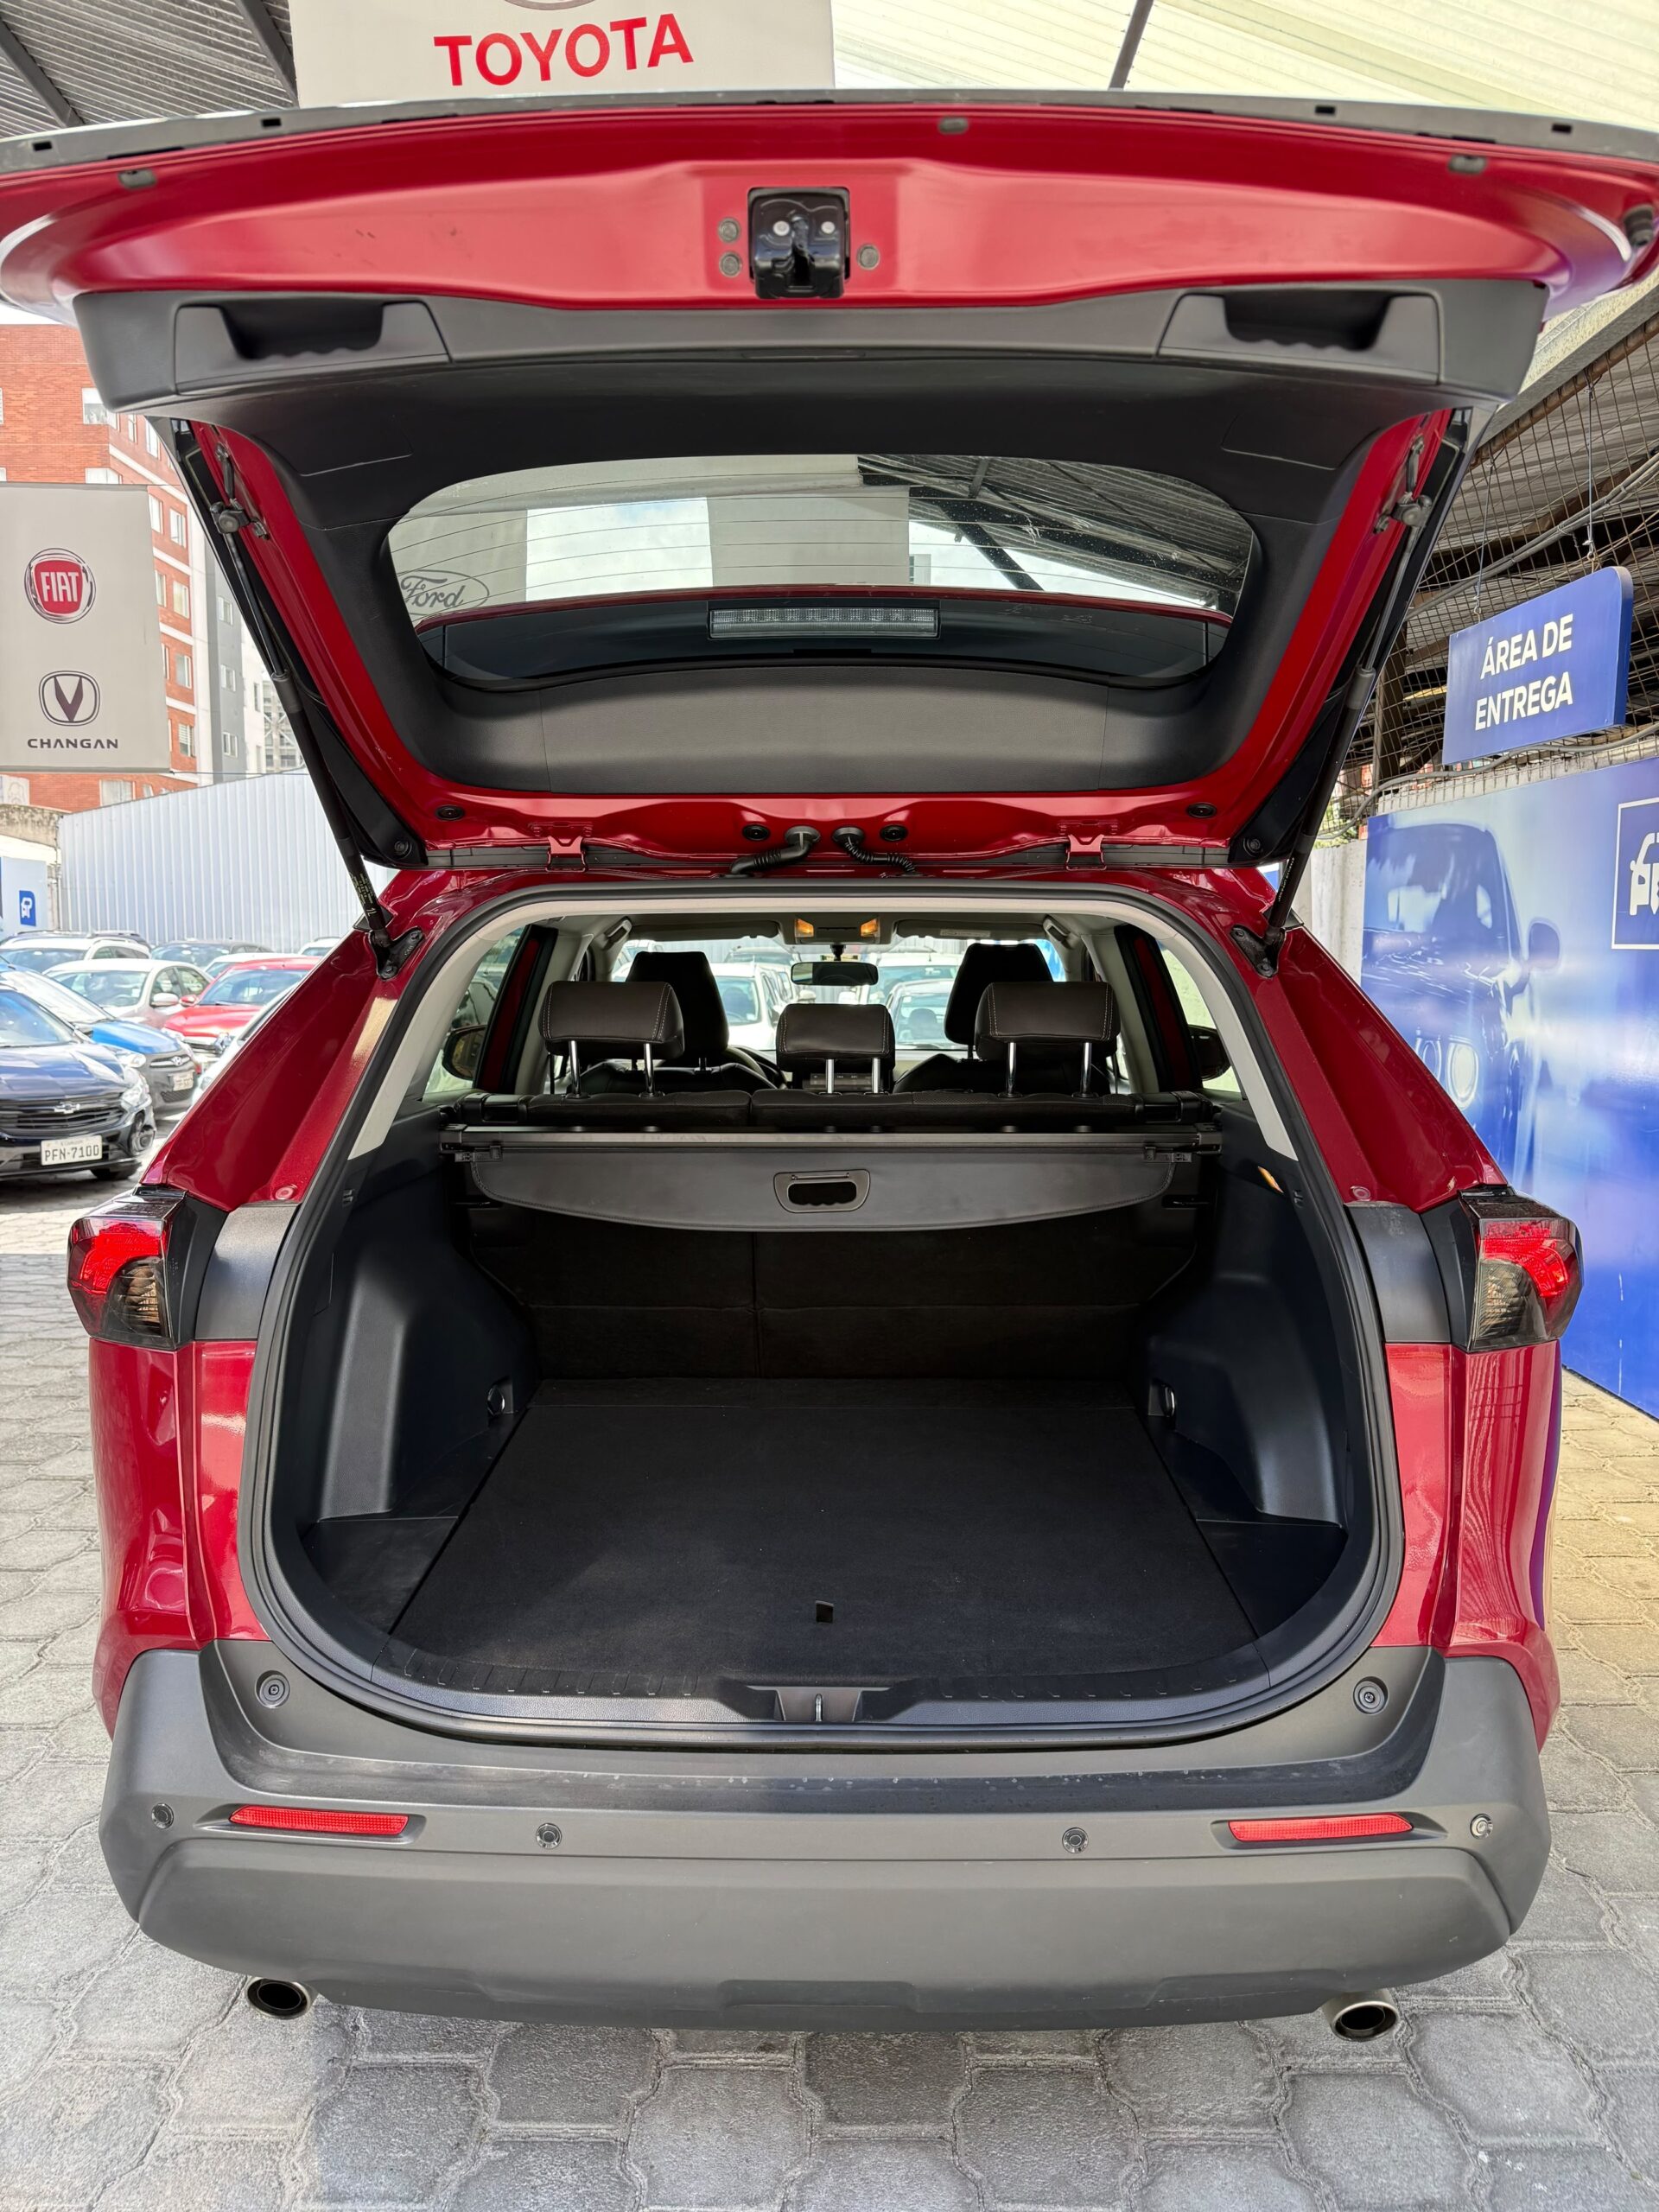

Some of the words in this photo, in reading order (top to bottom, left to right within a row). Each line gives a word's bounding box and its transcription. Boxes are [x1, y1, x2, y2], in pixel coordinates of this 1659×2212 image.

[433, 12, 694, 86] TOYOTA
[40, 571, 79, 602] FIAT
[400, 575, 467, 608] Ford
[1480, 629, 1538, 680] ÁREA
[1541, 613, 1573, 658] DE
[1475, 671, 1573, 731] ENTREGA
[27, 738, 118, 749] CHANGAN
[44, 1144, 99, 1161] PFN-7100
